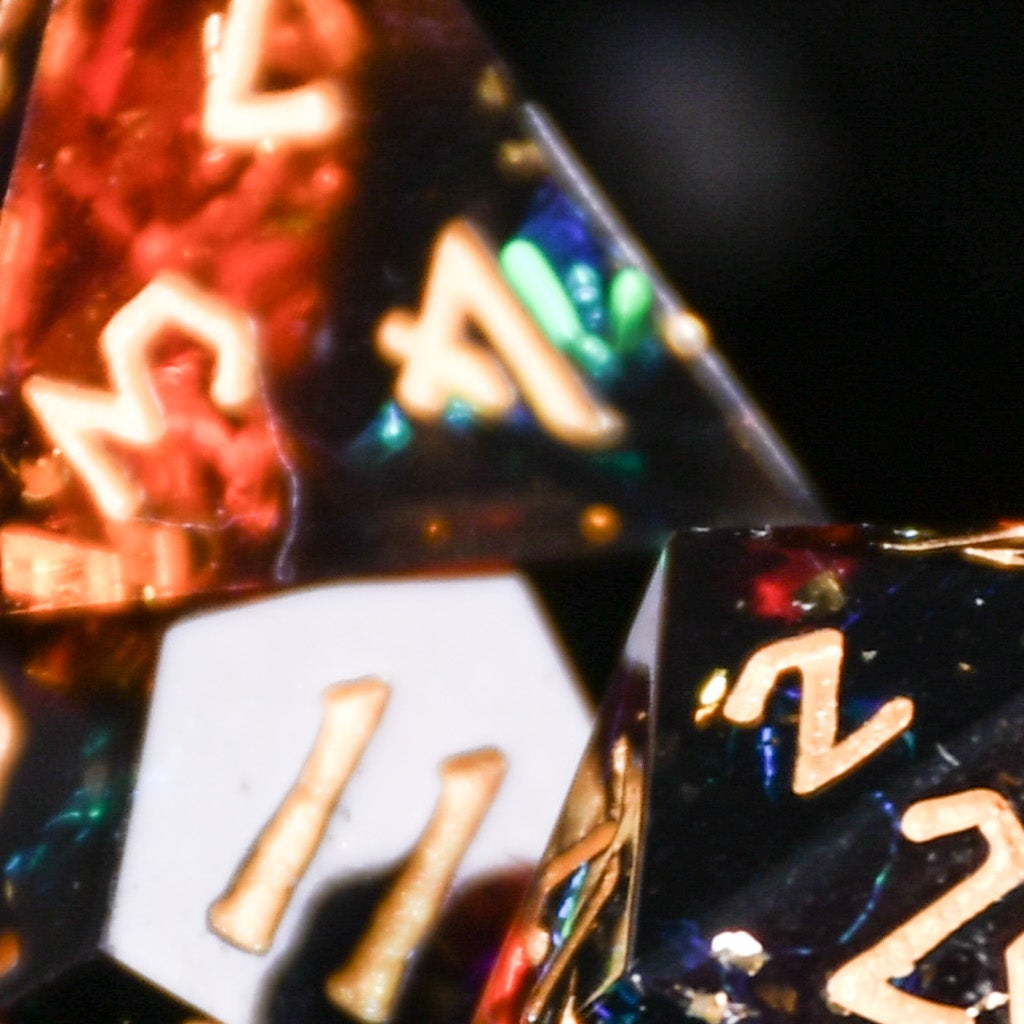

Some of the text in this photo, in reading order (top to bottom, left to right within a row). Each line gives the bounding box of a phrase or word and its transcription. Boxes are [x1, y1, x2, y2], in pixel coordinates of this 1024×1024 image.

[23, 273, 257, 521] 3
[376, 219, 625, 448] 4
[723, 628, 914, 795] 2
